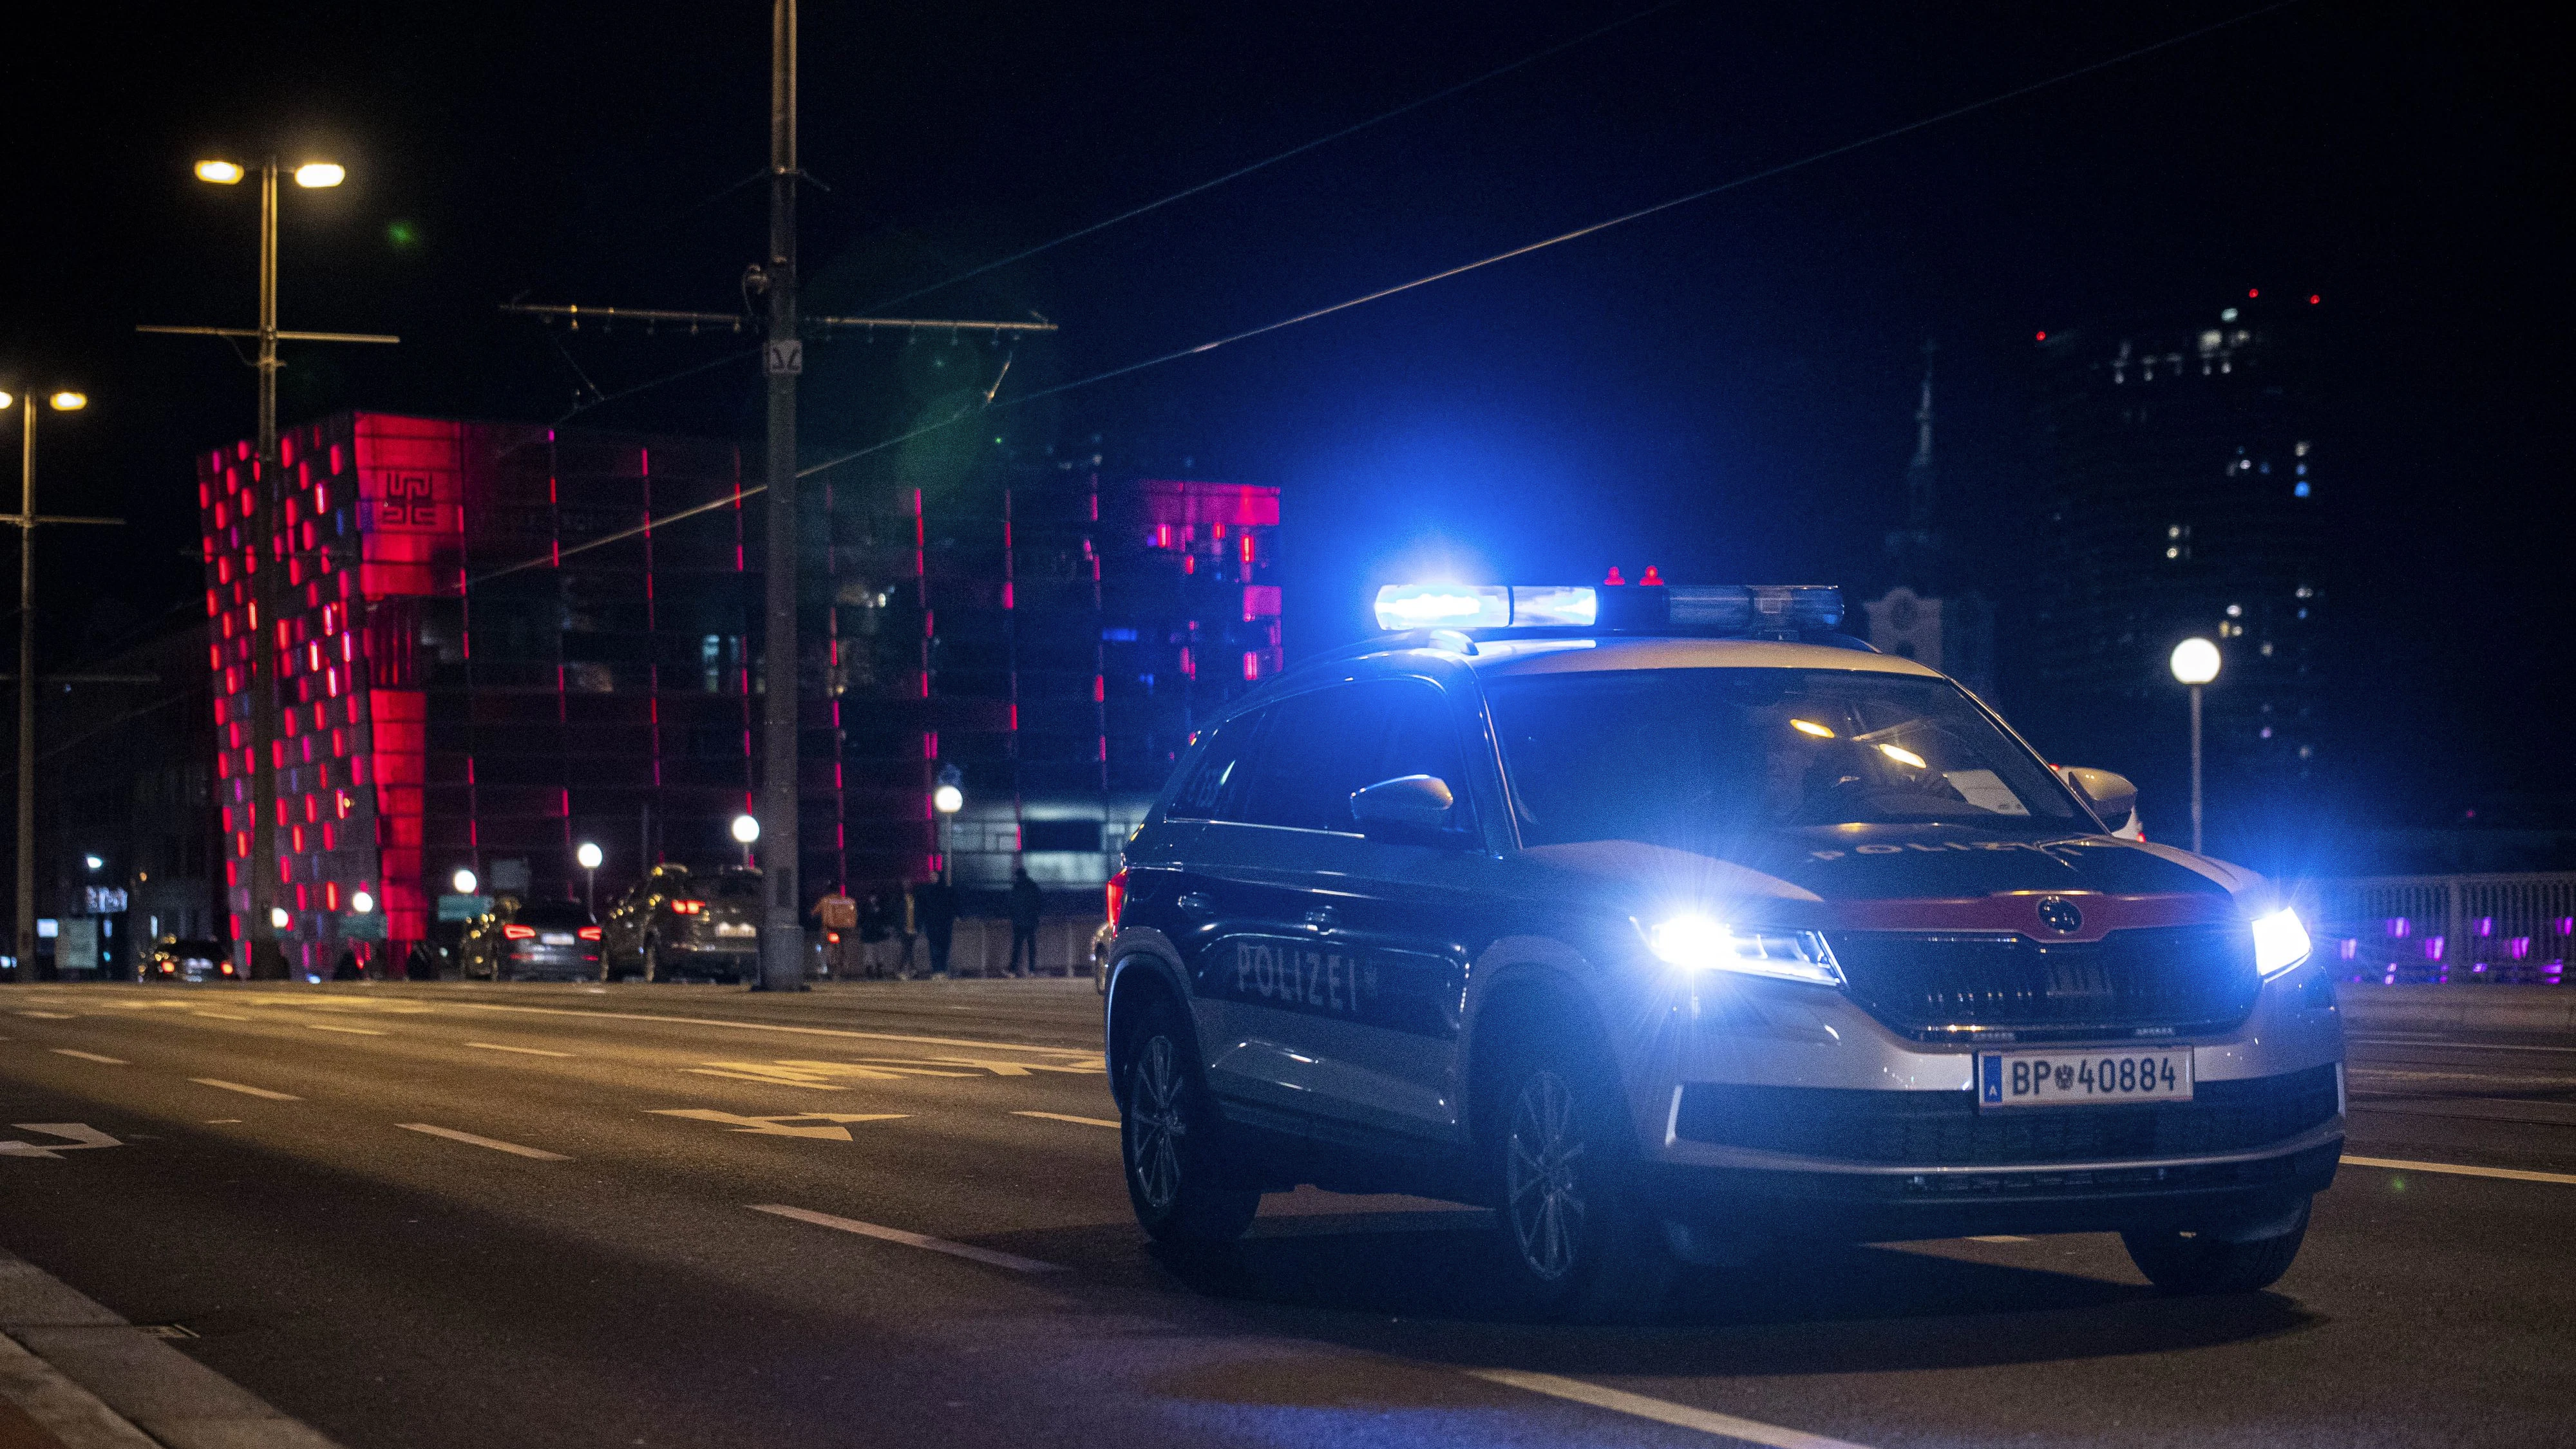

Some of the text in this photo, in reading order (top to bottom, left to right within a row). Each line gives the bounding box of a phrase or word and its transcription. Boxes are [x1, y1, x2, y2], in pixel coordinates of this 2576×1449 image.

[1237, 942, 1356, 1012] POLIZEI
[1989, 1057, 2176, 1095] A BP 40884
